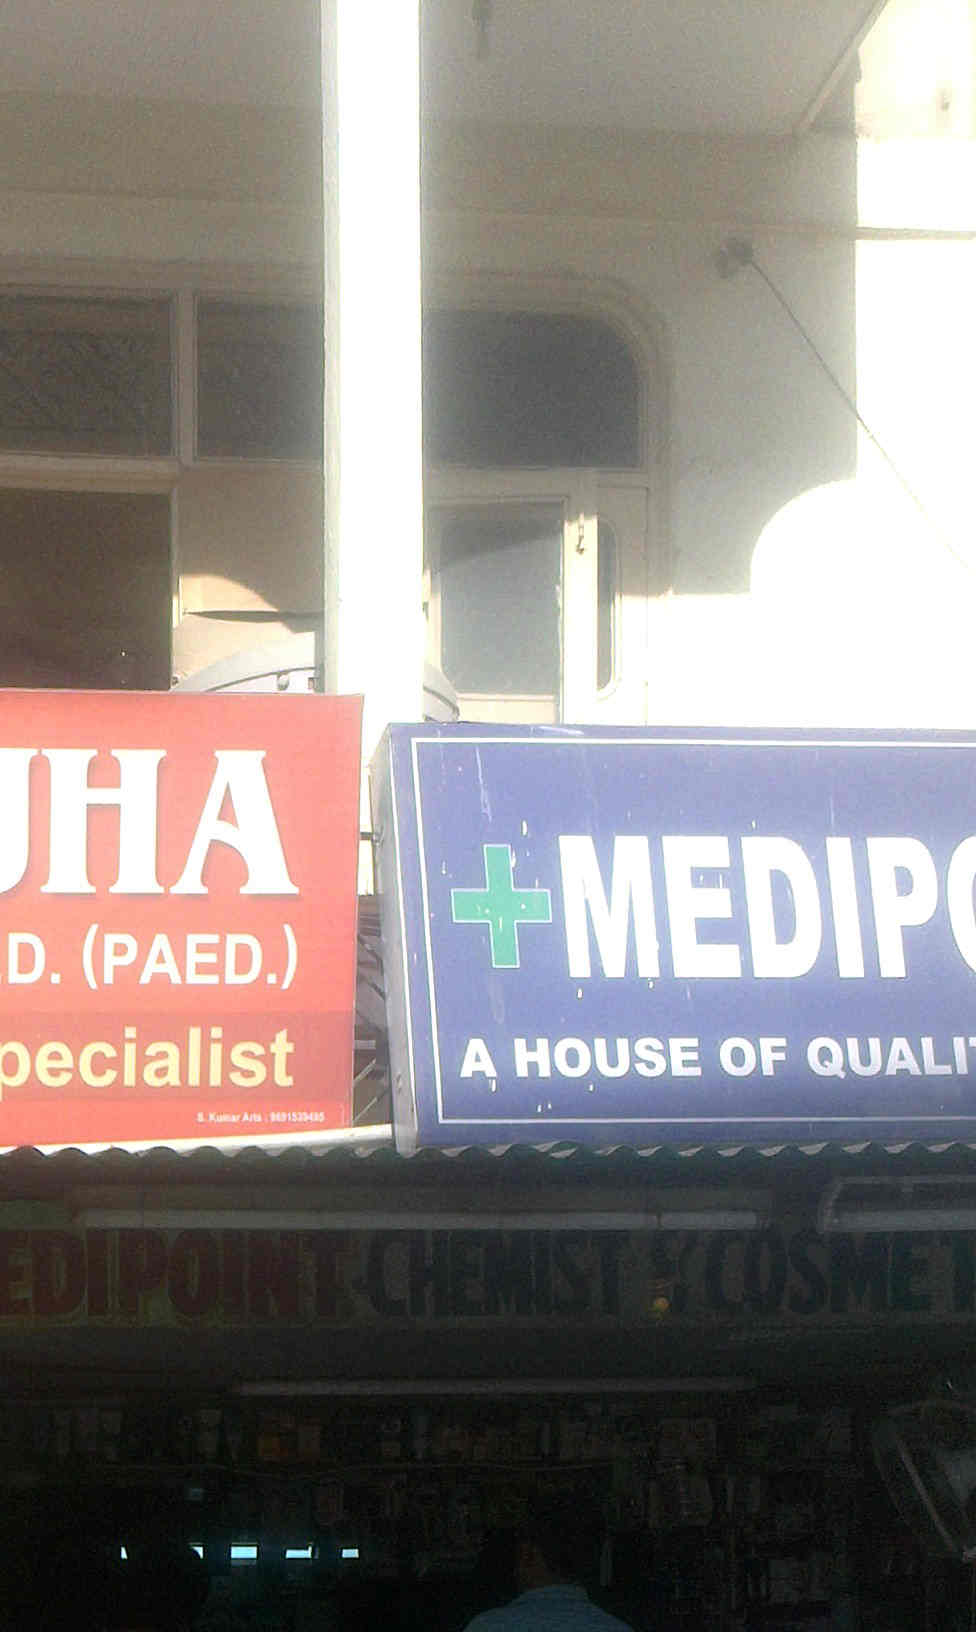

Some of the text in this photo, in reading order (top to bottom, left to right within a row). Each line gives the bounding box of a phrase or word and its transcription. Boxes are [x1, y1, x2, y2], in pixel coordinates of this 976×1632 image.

[83, 924, 298, 989] (PAED.)
[460, 1036, 976, 1079] A HOUSE OF QUALI
[368, 1229, 632, 1317] CHEMIST
